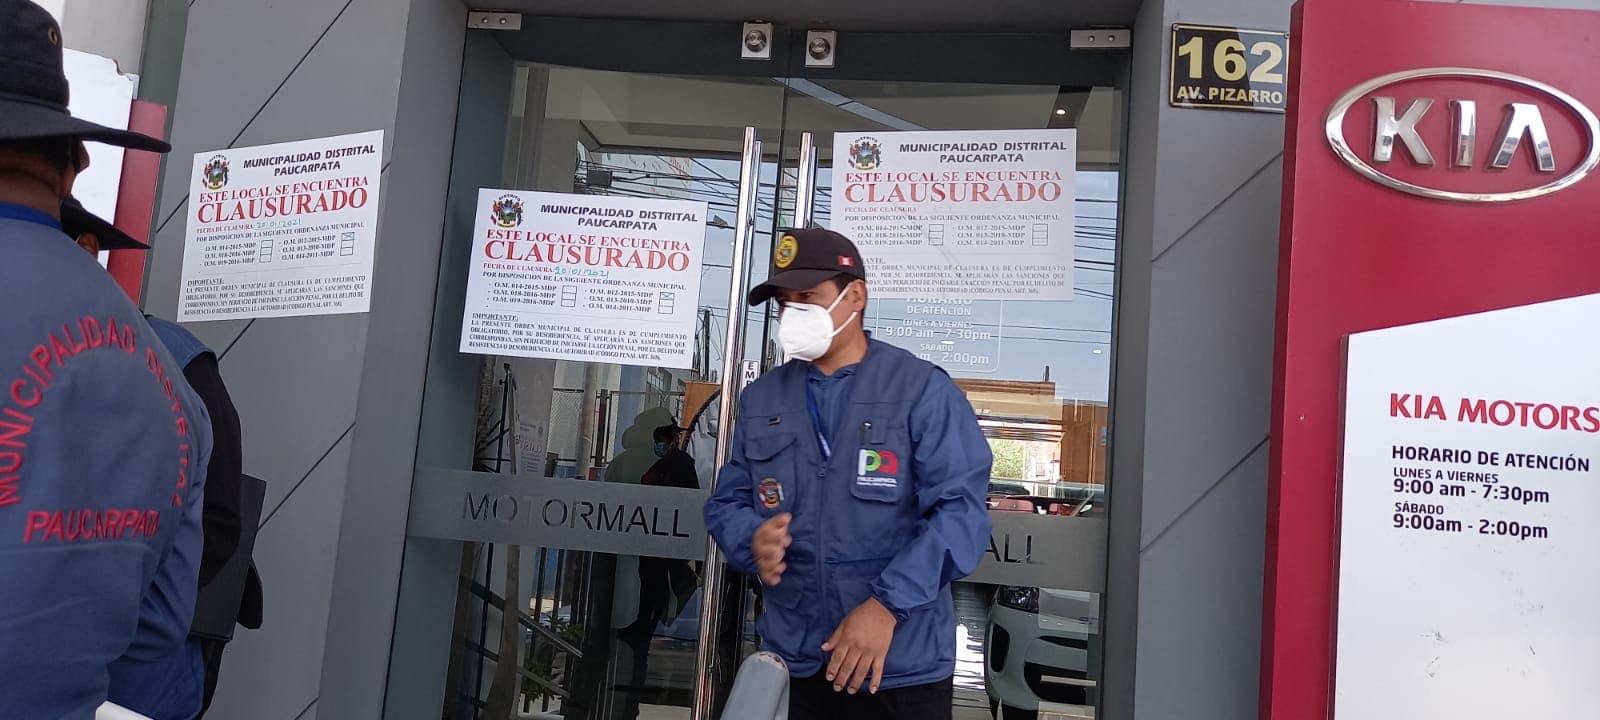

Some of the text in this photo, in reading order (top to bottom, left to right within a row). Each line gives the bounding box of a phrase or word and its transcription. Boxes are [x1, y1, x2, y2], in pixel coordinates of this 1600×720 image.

[1178, 36, 1283, 83] 162
[1176, 86, 1283, 104] AV. PIZARRO
[1371, 97, 1556, 172] KIA
[243, 151, 320, 168] MUNICIPALIDAD
[325, 144, 375, 159] DISTRITAL
[899, 141, 1066, 152] MUNICIPALIDAD DISTRITAL
[274, 160, 341, 176] PAUCARPATA
[939, 153, 1024, 163] PAUCARPATA
[846, 171, 1061, 182] ESTE LOCAL SE ENCUENTRA
[199, 175, 368, 203] ESTE LOCAL SE ENCUENTRA
[844, 182, 1061, 202] CLAUSURADO
[197, 186, 368, 224] CLAUSURADO
[540, 204, 698, 222] MUNICIPALIDAD DISTRITAL
[577, 217, 657, 231] PAUCARPATA
[486, 229, 690, 251] ESTE LOCAL SE ENCUENTRA
[483, 239, 690, 272] CLAUSURADO
[564, 276, 601, 284] SIGUIENTE
[602, 279, 646, 287] ORDENANZA
[907, 305, 919, 314] DE
[886, 326, 913, 337] 9:00
[916, 329, 934, 338] am
[942, 352, 989, 365] 2:00pm
[0, 315, 136, 507] MUNICIPALIDAD
[1390, 393, 1600, 433] KIA MOTORS
[1392, 445, 1590, 472] HORARIO DE ATENCIÓN
[1393, 467, 1499, 484] LUNES A VIERNES
[1393, 478, 1434, 495] 9:00
[1439, 483, 1466, 497] am
[1482, 484, 1550, 505] 7:30pm
[462, 491, 690, 538] MOTORMALL
[1394, 501, 1445, 515] SÁBADO
[1393, 514, 1462, 532] 9:00am
[1479, 519, 1549, 540] 2:00pm
